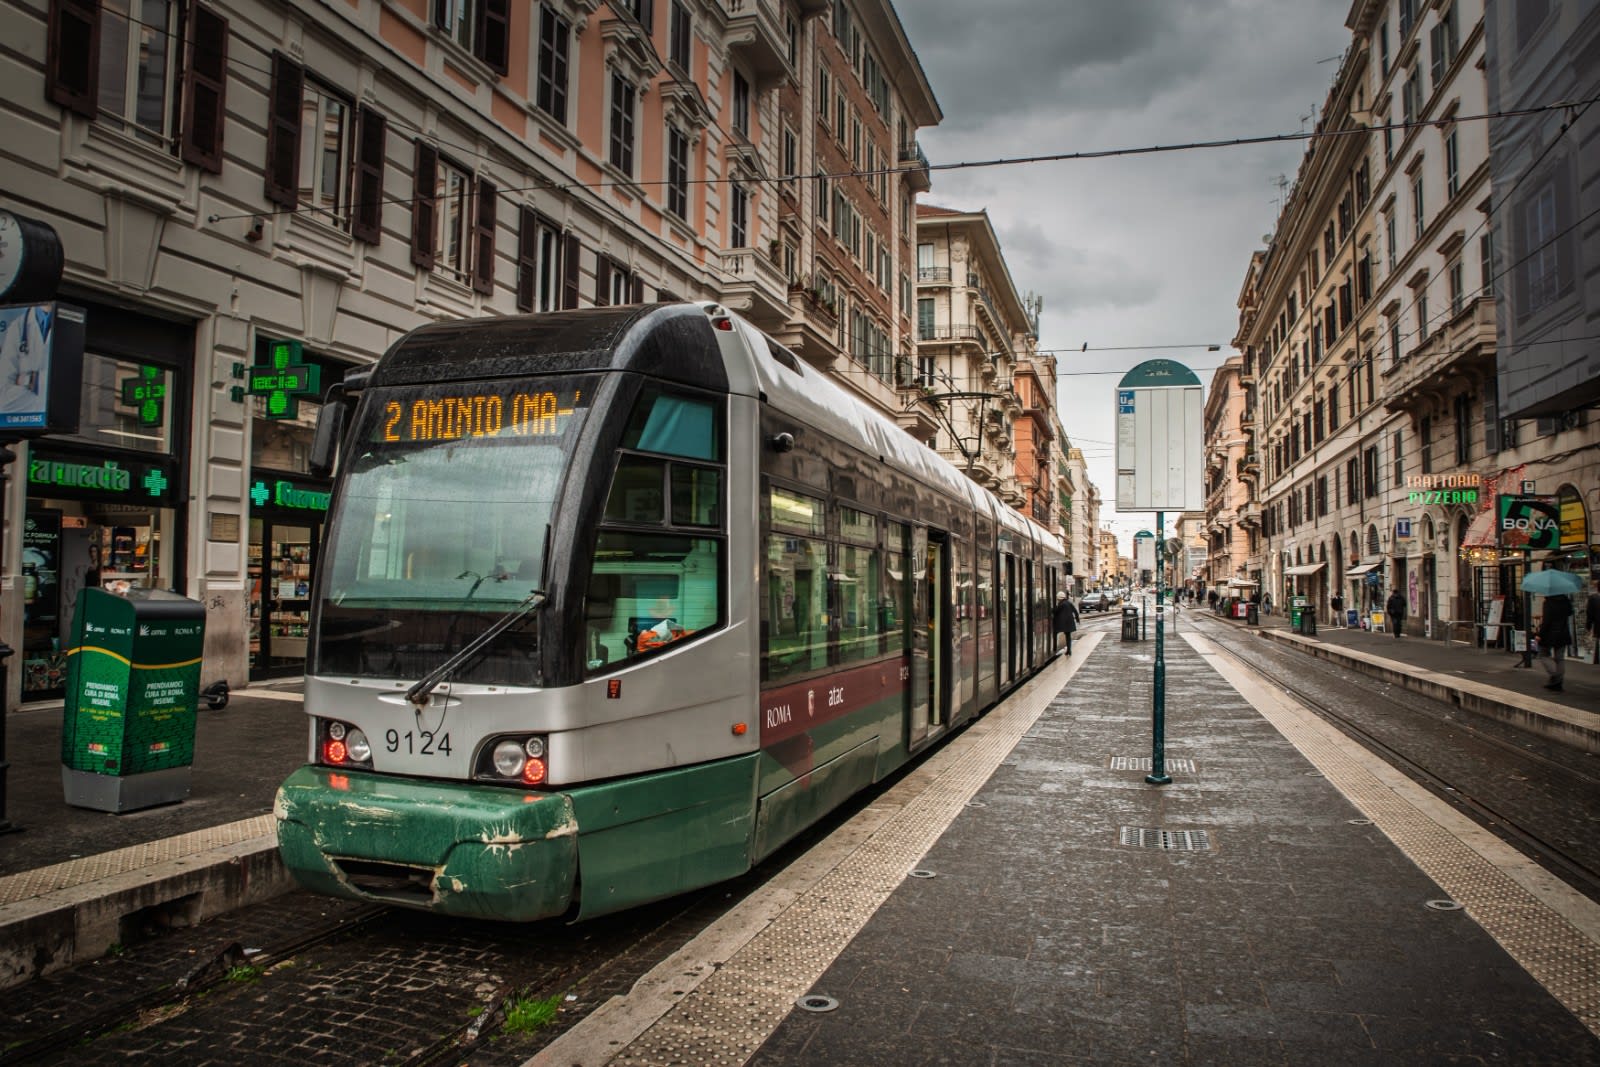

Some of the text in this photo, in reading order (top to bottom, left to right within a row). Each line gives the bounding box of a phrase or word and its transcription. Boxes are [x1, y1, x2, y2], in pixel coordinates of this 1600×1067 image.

[384, 401, 401, 442] 2
[411, 395, 502, 440] AMINIO
[30, 459, 130, 491] armacia
[1407, 474, 1481, 489] TRATTORIA
[1408, 490, 1478, 506] PIZZERIA
[1503, 518, 1559, 531] BONA
[144, 690, 160, 699] CURA
[161, 689, 167, 697] DI
[146, 680, 184, 690] PRENDIAMOCI
[828, 685, 844, 707] atac
[767, 704, 792, 729] ROMA
[385, 728, 452, 756] 9124
